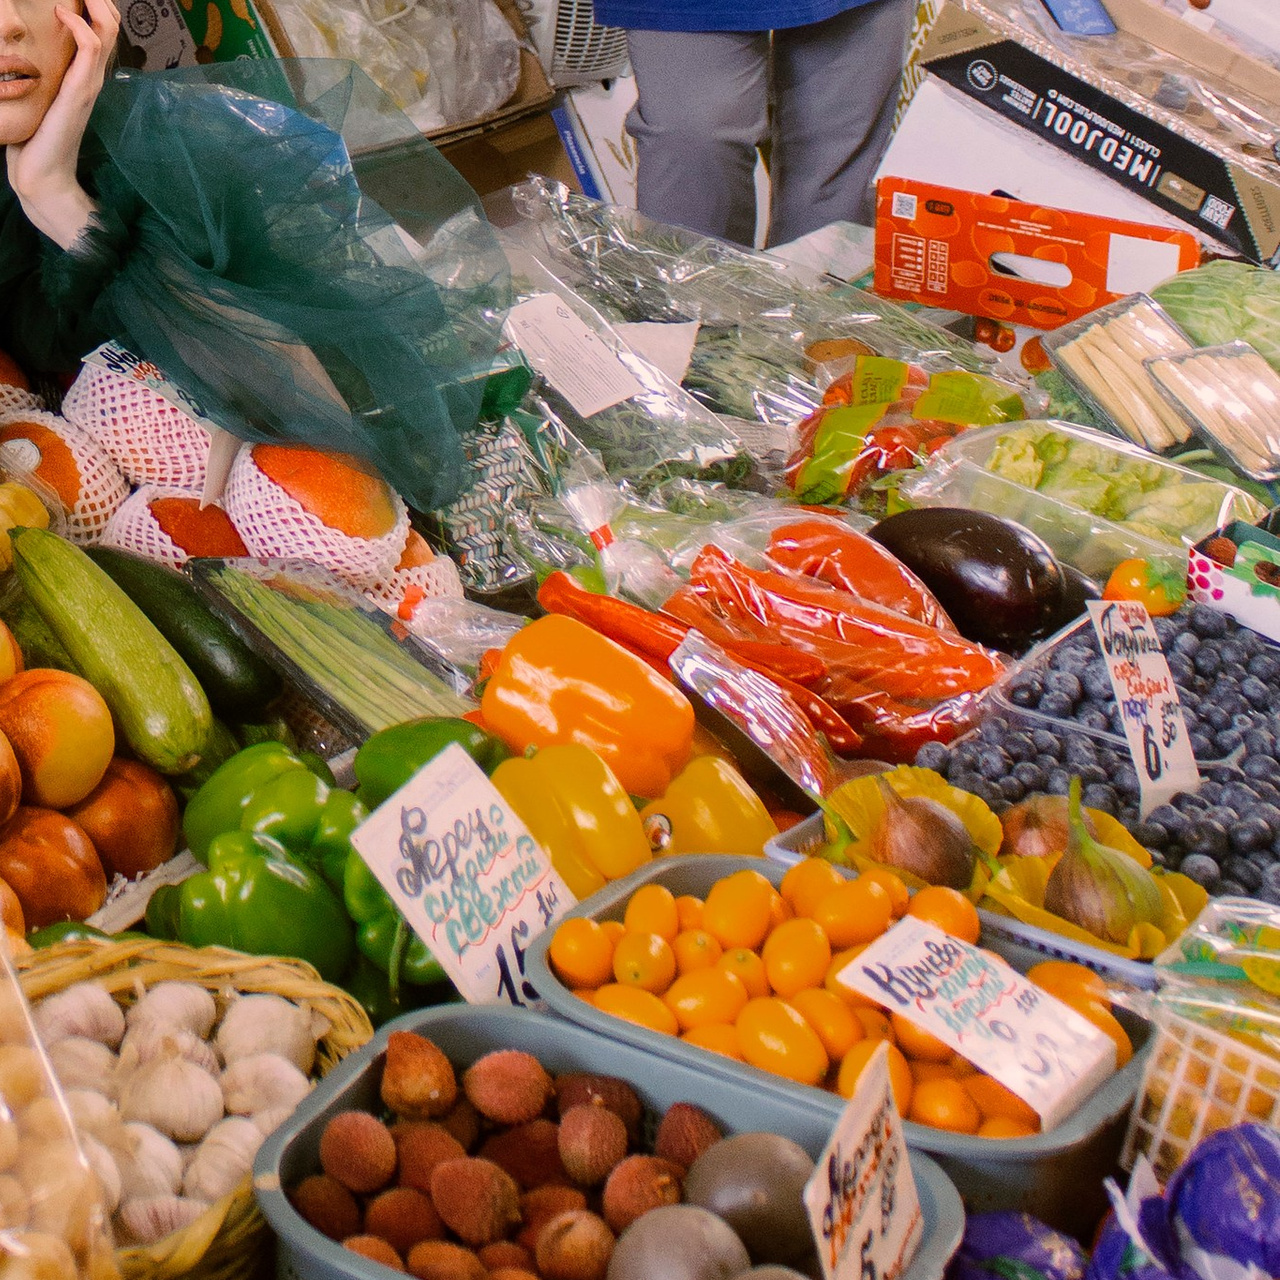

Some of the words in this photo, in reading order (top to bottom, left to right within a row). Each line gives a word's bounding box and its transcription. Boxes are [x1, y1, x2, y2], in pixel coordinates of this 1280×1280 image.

[1043, 101, 1153, 184] MEDJOOL
[1205, 195, 1236, 216] FOOD
[1199, 206, 1227, 230] RAW
